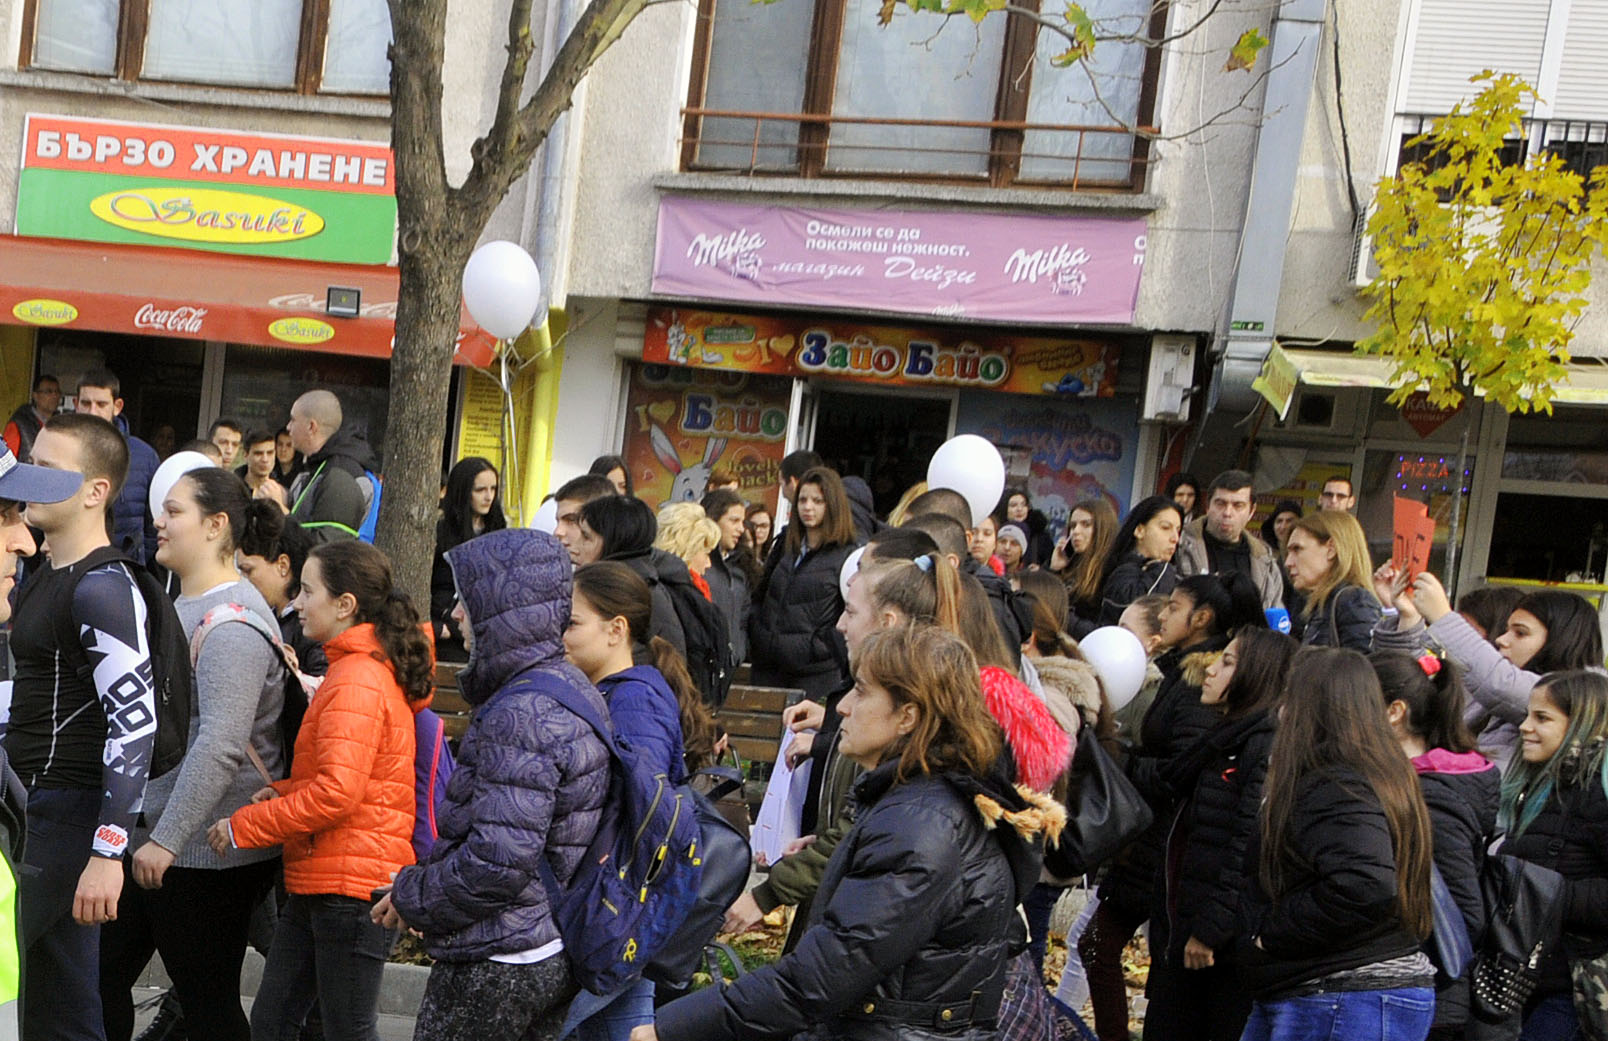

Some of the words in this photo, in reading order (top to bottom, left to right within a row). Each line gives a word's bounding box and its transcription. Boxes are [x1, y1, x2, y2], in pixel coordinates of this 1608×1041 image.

[37, 131, 176, 168] БЪРЗО
[191, 144, 387, 186] ХРАНЕНЕ
[687, 229, 767, 266] Milka
[897, 228, 921, 241] да
[772, 263, 865, 279] магазин
[884, 257, 977, 290] Дейзи
[1005, 244, 1091, 284] Milka
[802, 332, 897, 373] Зайо
[905, 341, 1004, 381] Байо
[1400, 461, 1449, 478] PIZZA
